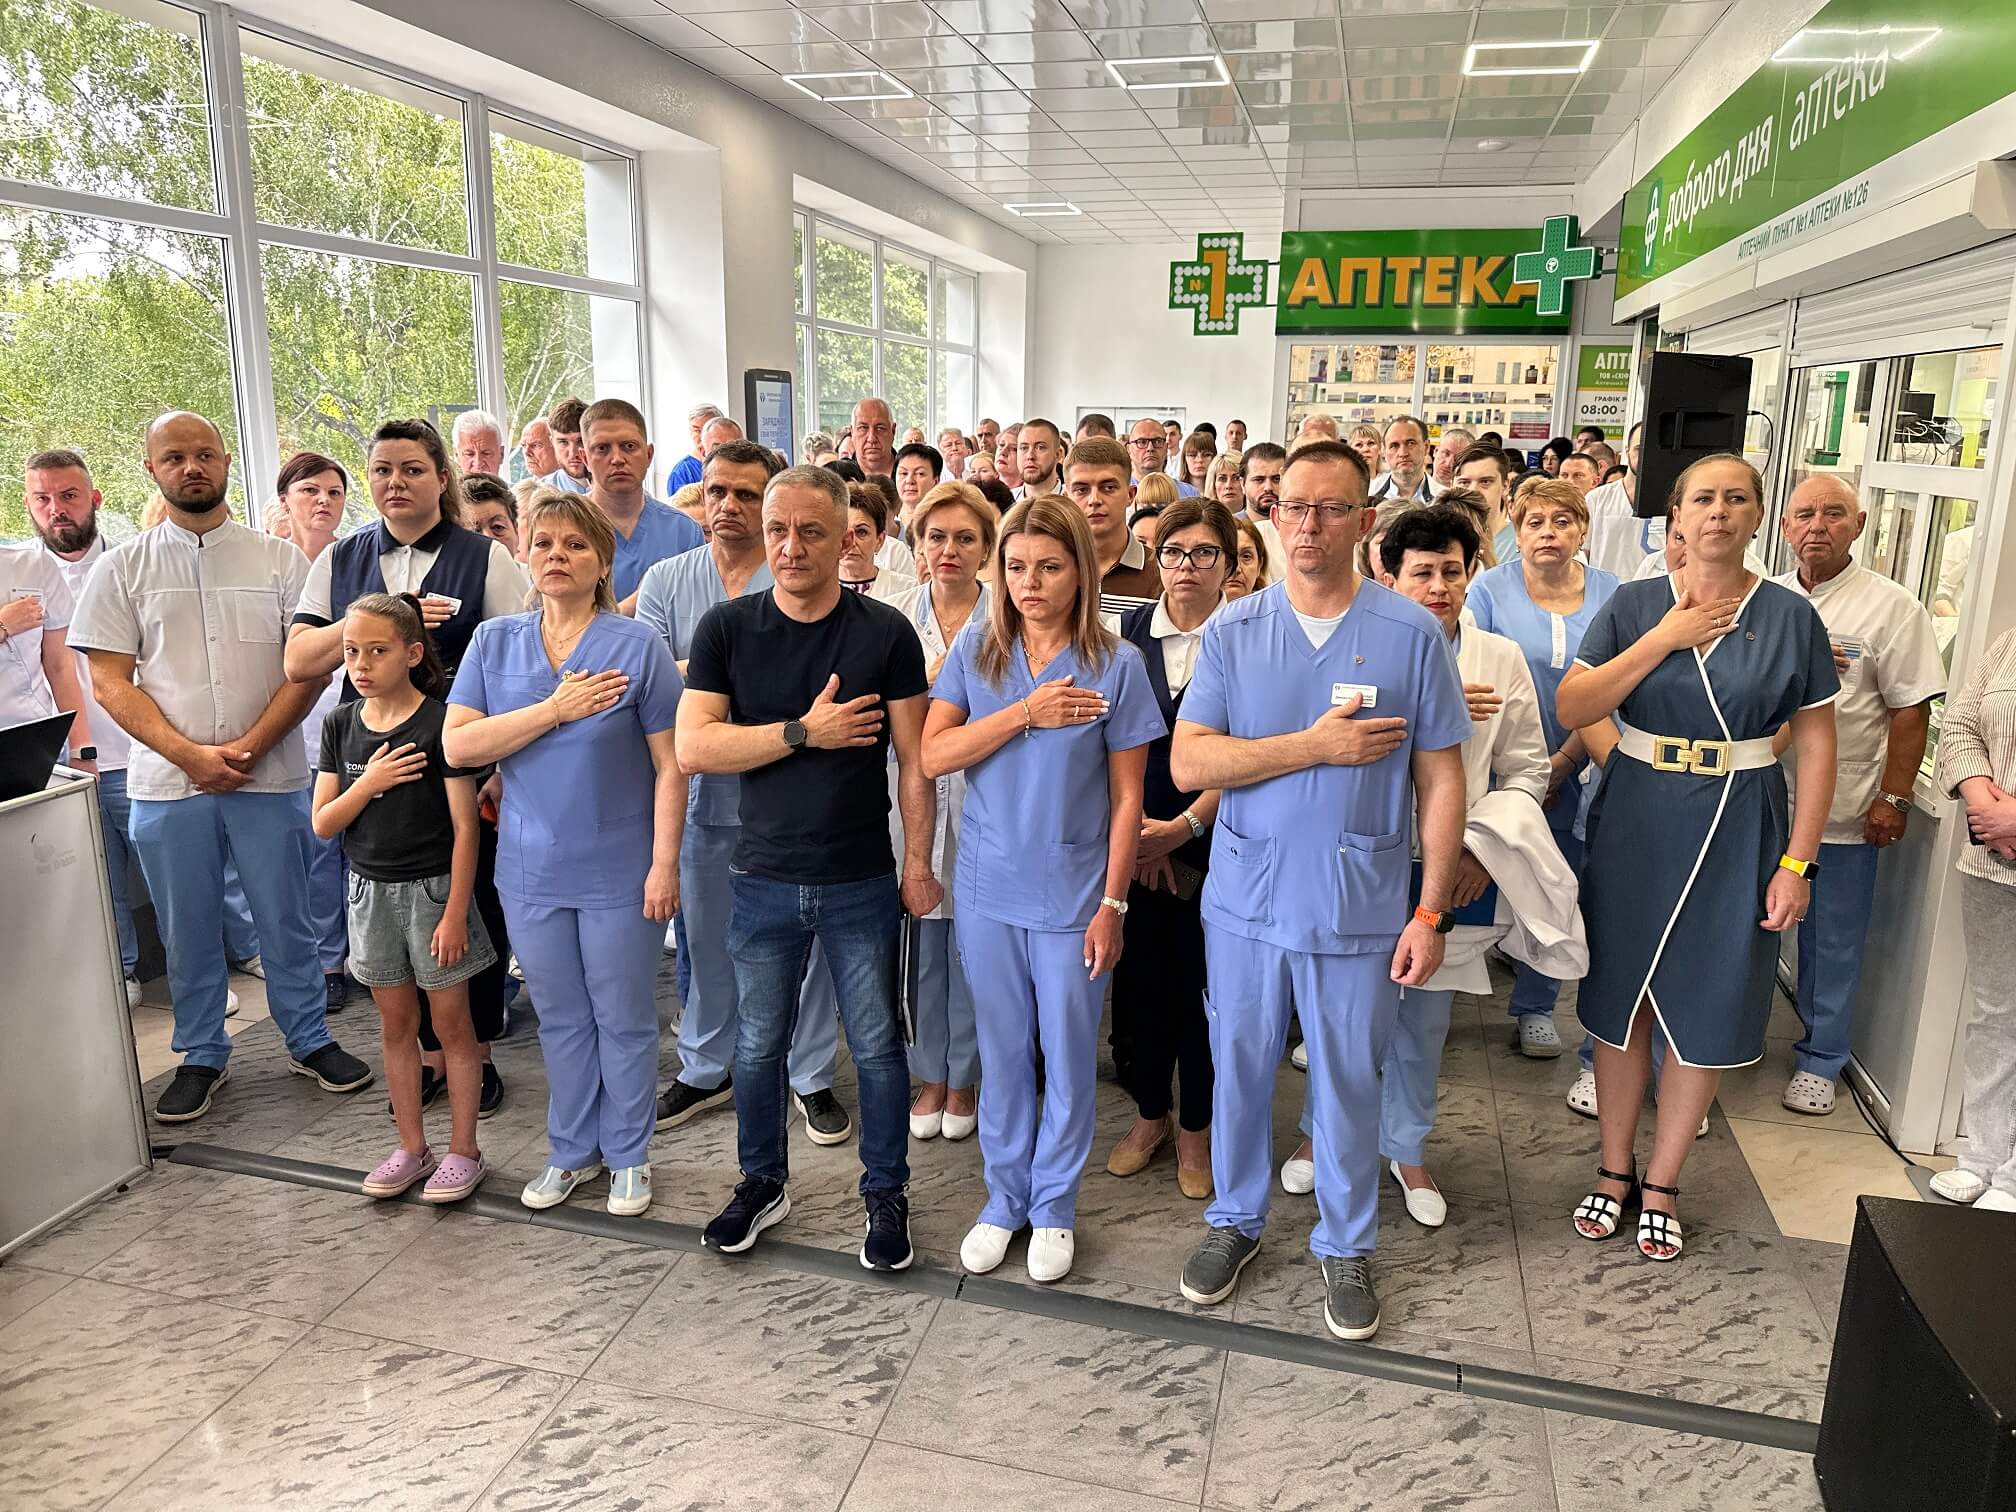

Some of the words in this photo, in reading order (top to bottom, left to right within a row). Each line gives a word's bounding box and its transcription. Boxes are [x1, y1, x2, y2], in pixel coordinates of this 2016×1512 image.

[1663, 149, 1730, 246] доброго
[1730, 115, 1774, 204] дня
[1789, 48, 1889, 151] аптека
[1737, 225, 1771, 260] АПТЕЧНИЙ
[1771, 217, 1795, 246] ПУНКТ
[1795, 211, 1808, 234] №1
[1807, 194, 1841, 231] АПТЕКИ
[1841, 181, 1869, 213] №126
[1203, 250, 1227, 319] 1
[1580, 404, 1618, 415] 08:00
